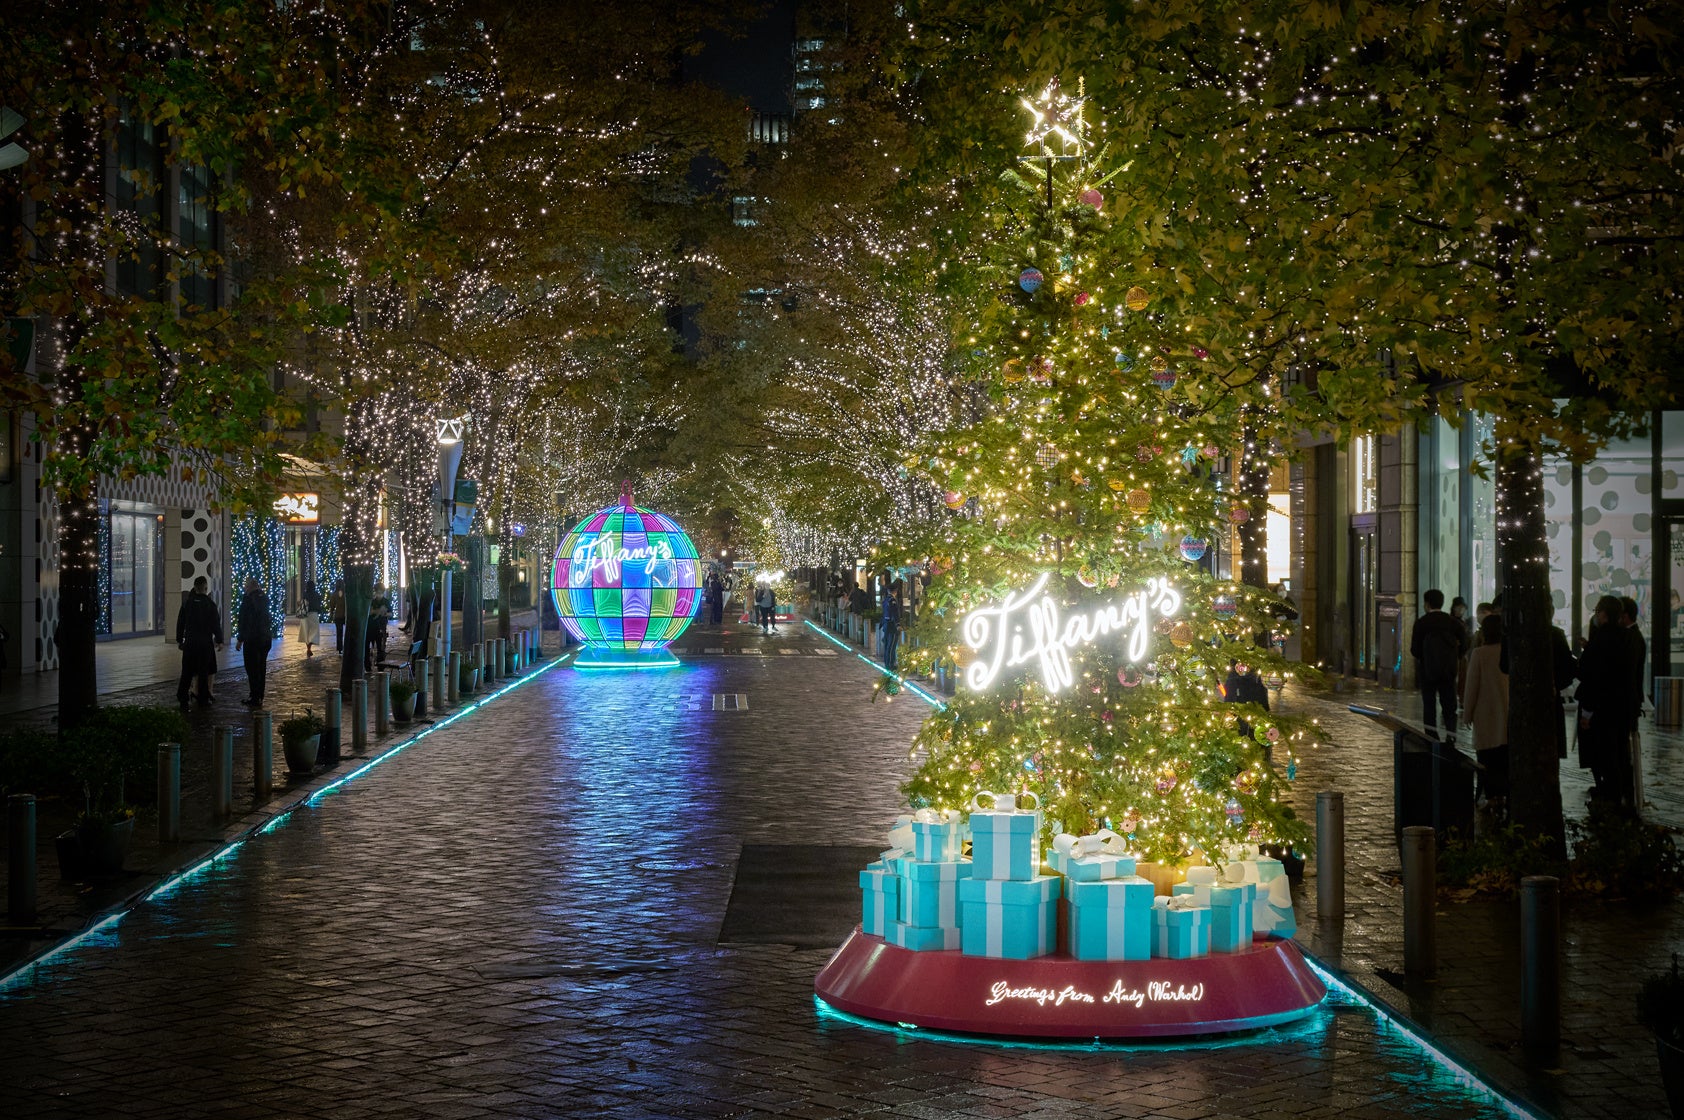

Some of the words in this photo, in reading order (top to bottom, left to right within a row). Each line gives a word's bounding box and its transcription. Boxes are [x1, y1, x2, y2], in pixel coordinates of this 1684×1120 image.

[573, 530, 672, 584] Tiffany's
[963, 571, 1182, 693] Tiffany's
[985, 981, 1055, 1006] Greetings
[1055, 985, 1095, 1006] from
[1103, 979, 1146, 1008] Andy
[1147, 981, 1204, 1001] (Warhol)
